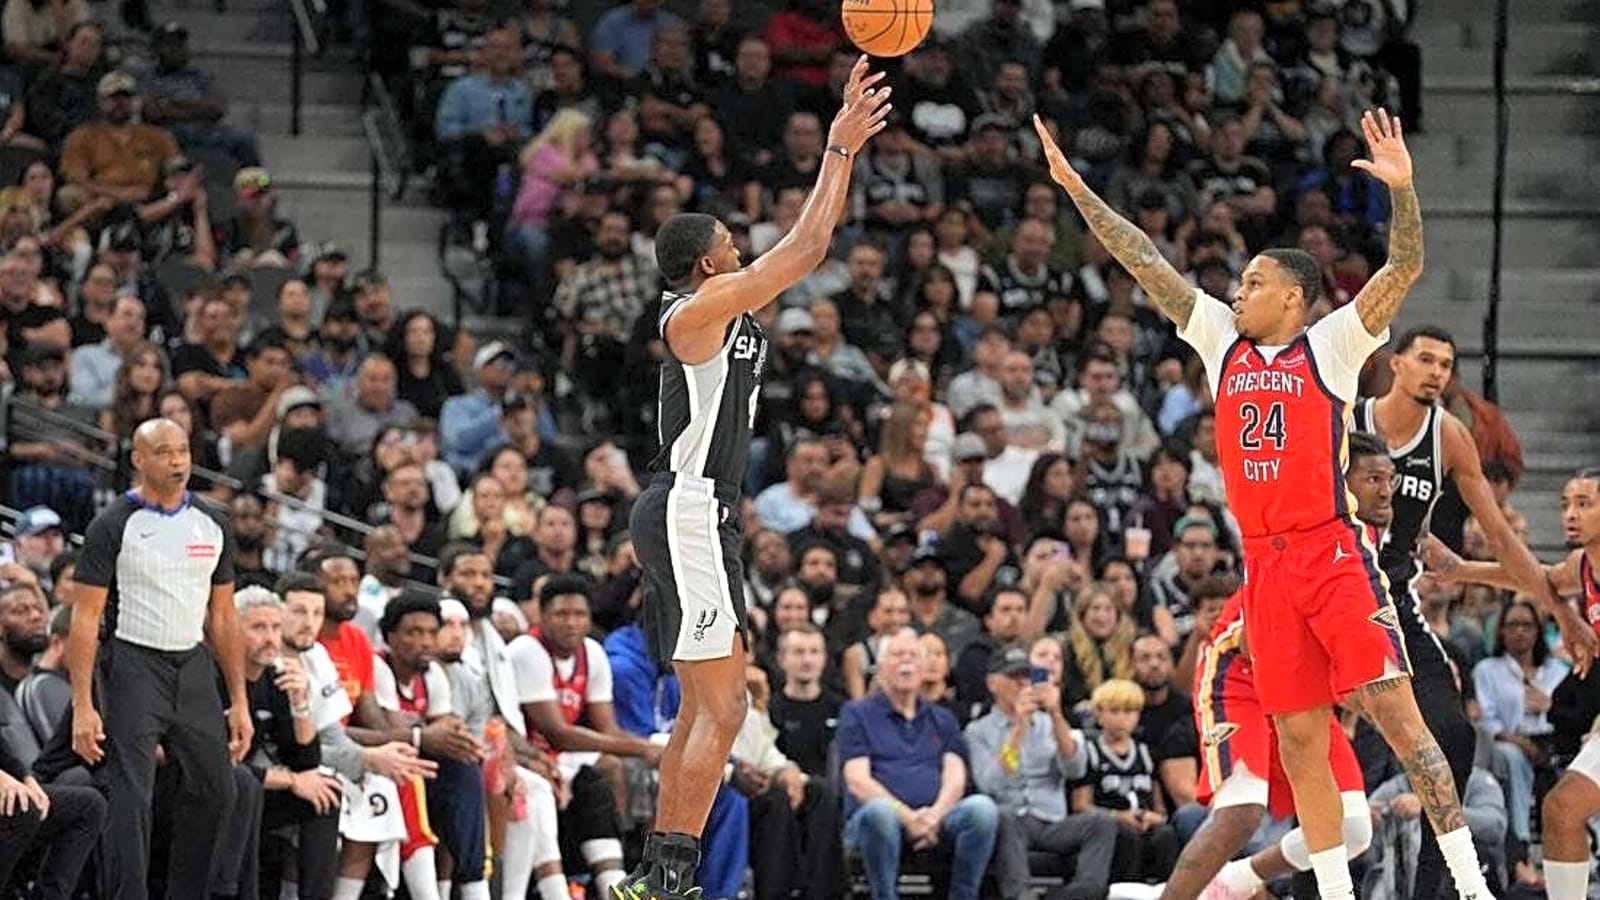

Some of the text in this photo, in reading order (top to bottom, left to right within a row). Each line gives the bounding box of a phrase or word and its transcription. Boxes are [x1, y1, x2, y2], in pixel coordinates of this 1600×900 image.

[1226, 370, 1304, 397] CRESCENT
[1239, 401, 1287, 450] 24
[1243, 458, 1281, 482] CITY
